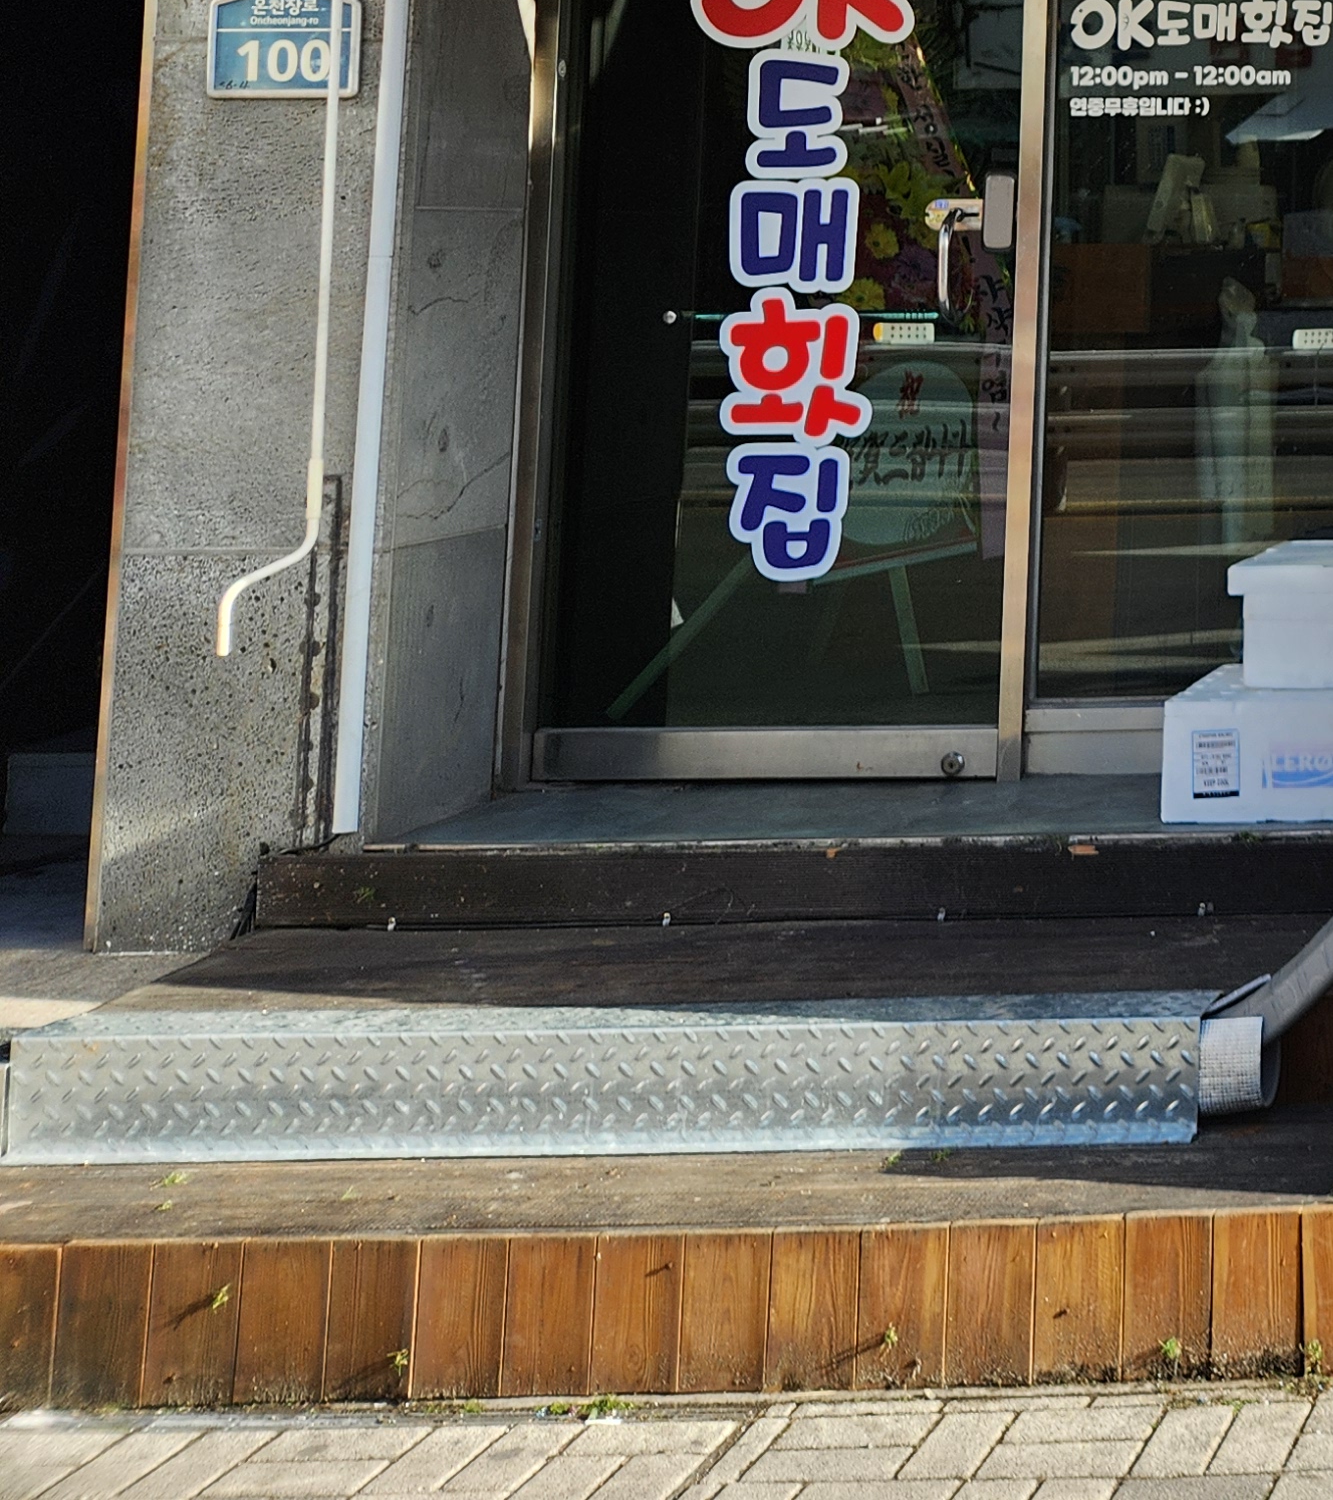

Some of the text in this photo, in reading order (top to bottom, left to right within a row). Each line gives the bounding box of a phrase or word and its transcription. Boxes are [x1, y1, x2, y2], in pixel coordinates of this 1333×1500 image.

[250, 16, 319, 27] Oncheonjang-ro
[236, 39, 331, 83] 100
[1070, 66, 1169, 90] 12:00pm
[1193, 66, 1292, 87] 12:00am
[1069, 97, 1192, 117] 연중무휴입니다
[729, 58, 865, 572] 도매횟집
